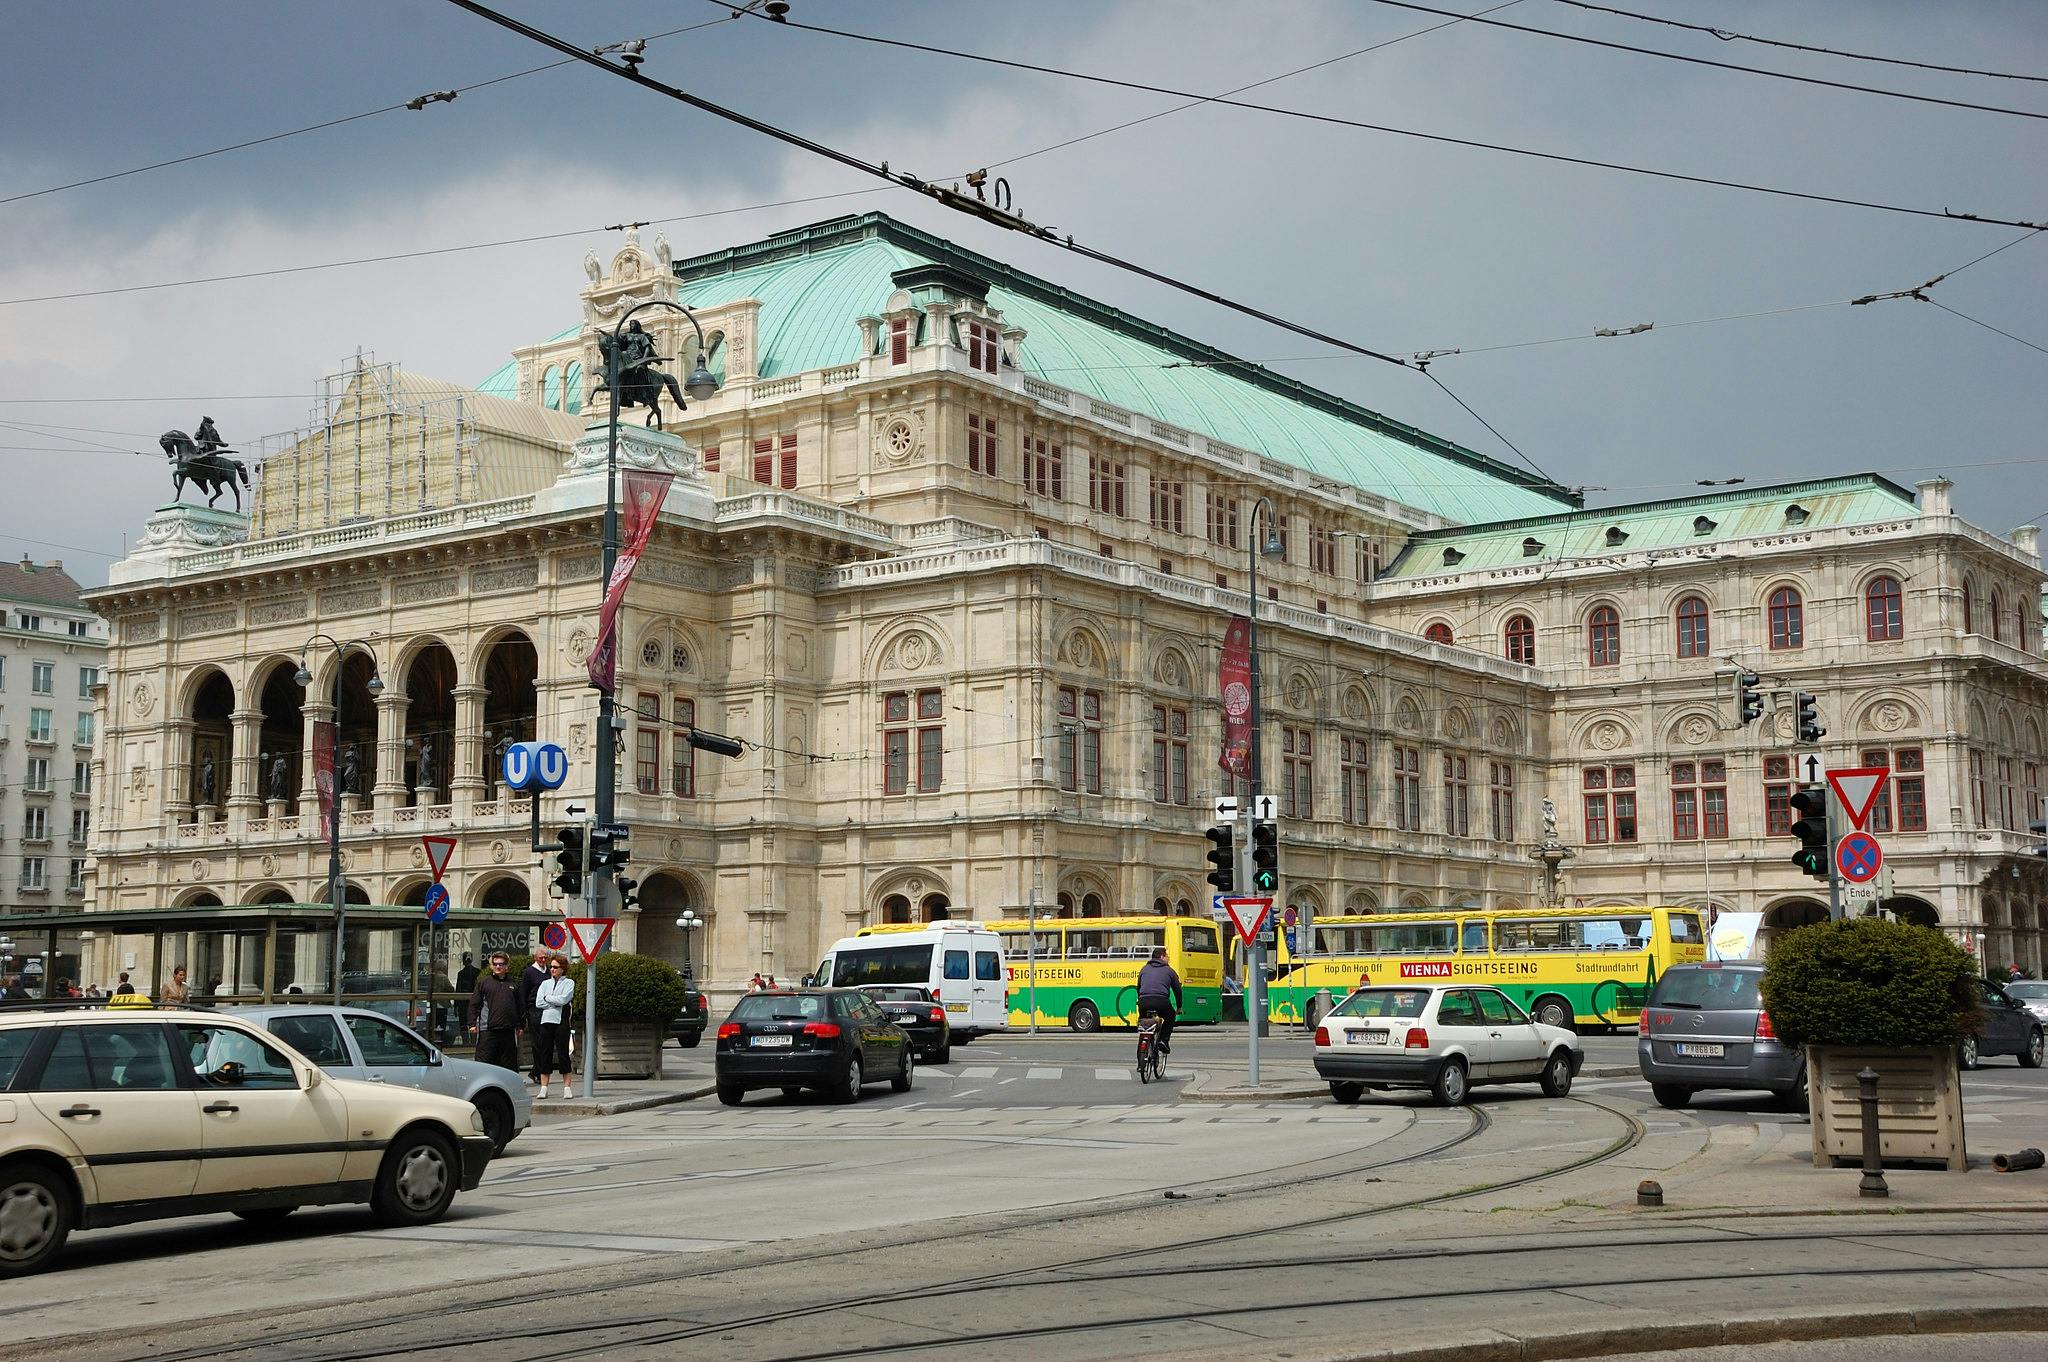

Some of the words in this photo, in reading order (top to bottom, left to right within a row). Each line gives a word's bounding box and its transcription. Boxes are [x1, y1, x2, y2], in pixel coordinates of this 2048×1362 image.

[507, 752, 527, 783] U
[540, 751, 562, 782] U
[1850, 888, 1870, 897] Ende
[421, 931, 535, 949] OPERNASSAGE
[1324, 964, 1340, 975] Hop
[1341, 963, 1351, 973] On
[1353, 963, 1369, 974] Hop
[1371, 963, 1382, 972] Off
[1402, 964, 1450, 976] VIENNA
[1453, 963, 1538, 974] SIGHTSEEING
[1575, 963, 1639, 973] Stadtrundfahrt
[1101, 970, 1140, 979] Stadtrundfa
